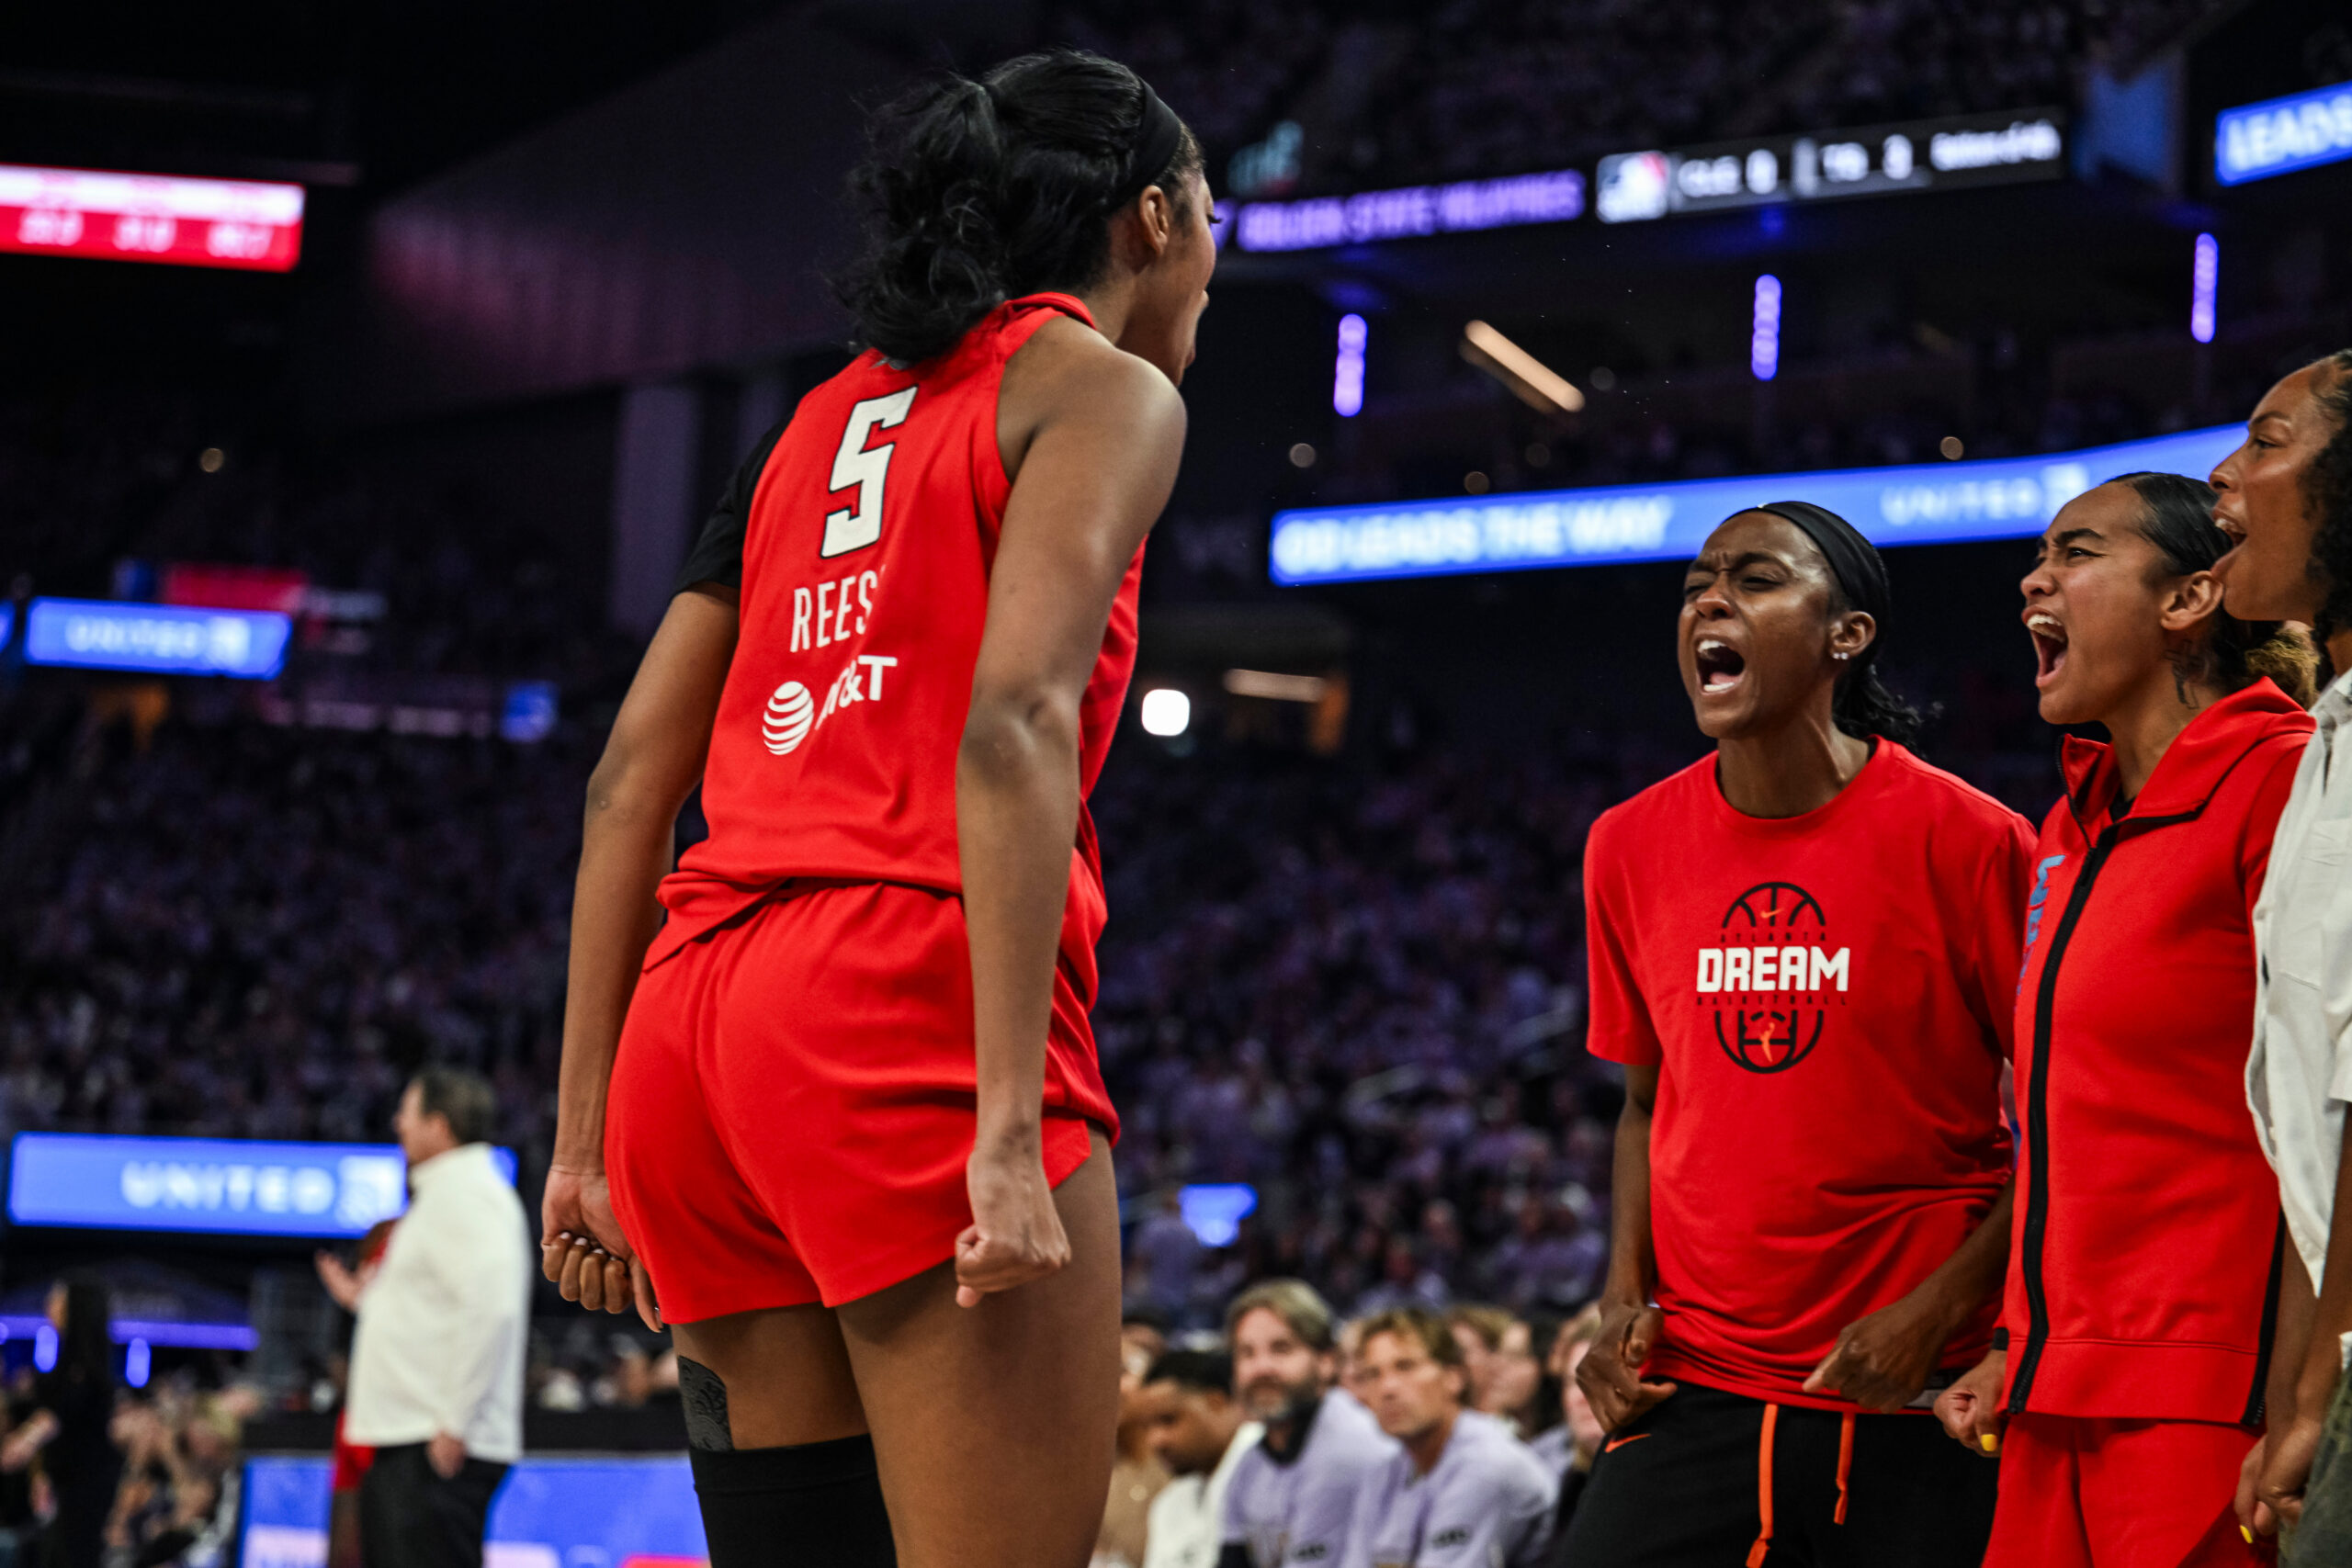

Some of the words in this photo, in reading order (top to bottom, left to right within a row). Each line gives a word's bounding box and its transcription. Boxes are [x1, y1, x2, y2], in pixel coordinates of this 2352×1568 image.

[820, 383, 919, 559] 5
[790, 566, 885, 653] REES
[1696, 945, 1850, 992] DREAM
[121, 1160, 334, 1214] UNITED
